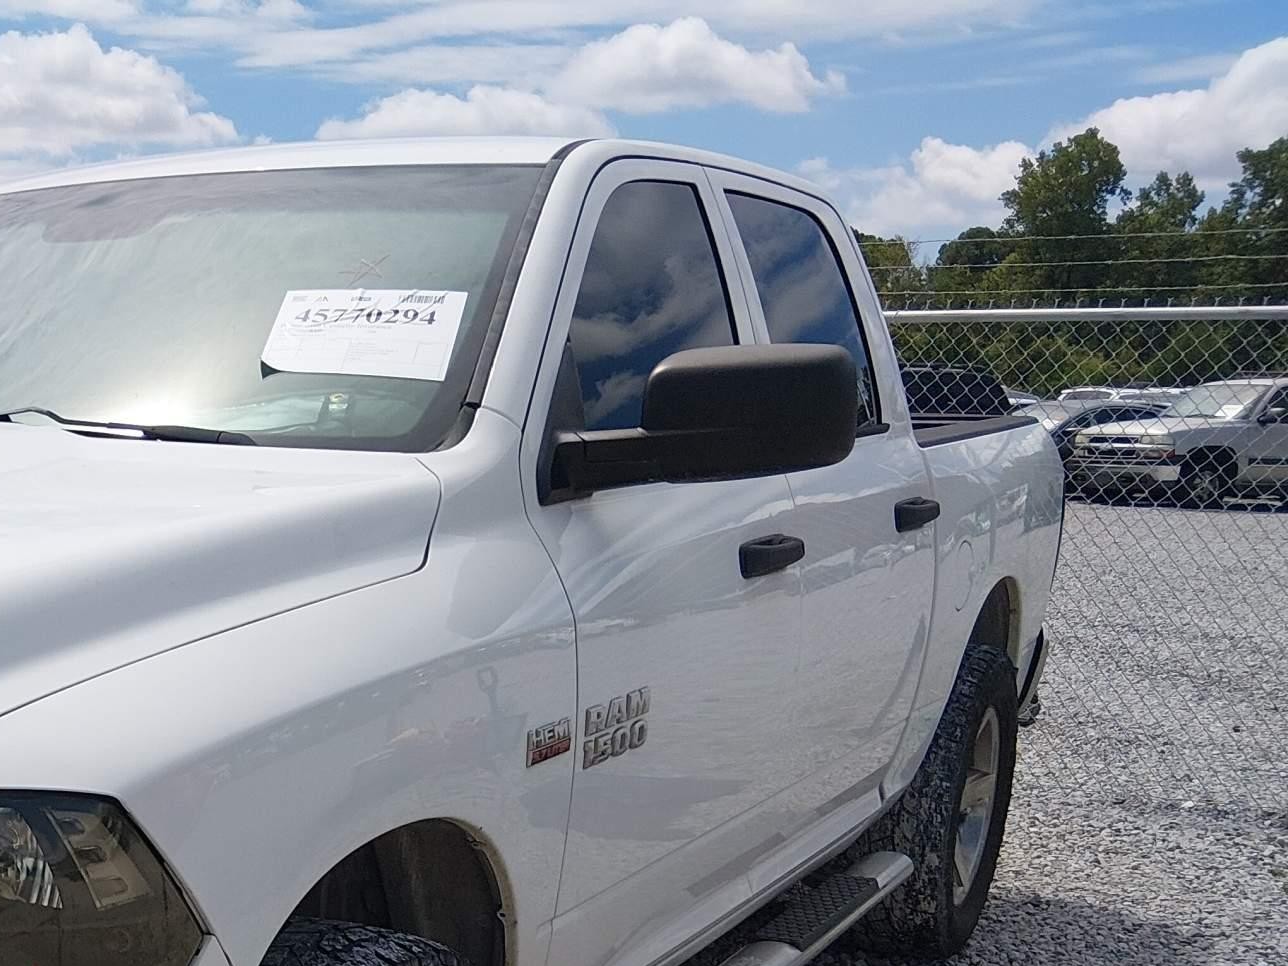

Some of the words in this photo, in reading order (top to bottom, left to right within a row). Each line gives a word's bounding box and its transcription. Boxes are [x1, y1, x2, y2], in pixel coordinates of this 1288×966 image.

[295, 307, 437, 325] 45770294
[584, 685, 651, 737] RAM
[583, 719, 649, 770] 1500
